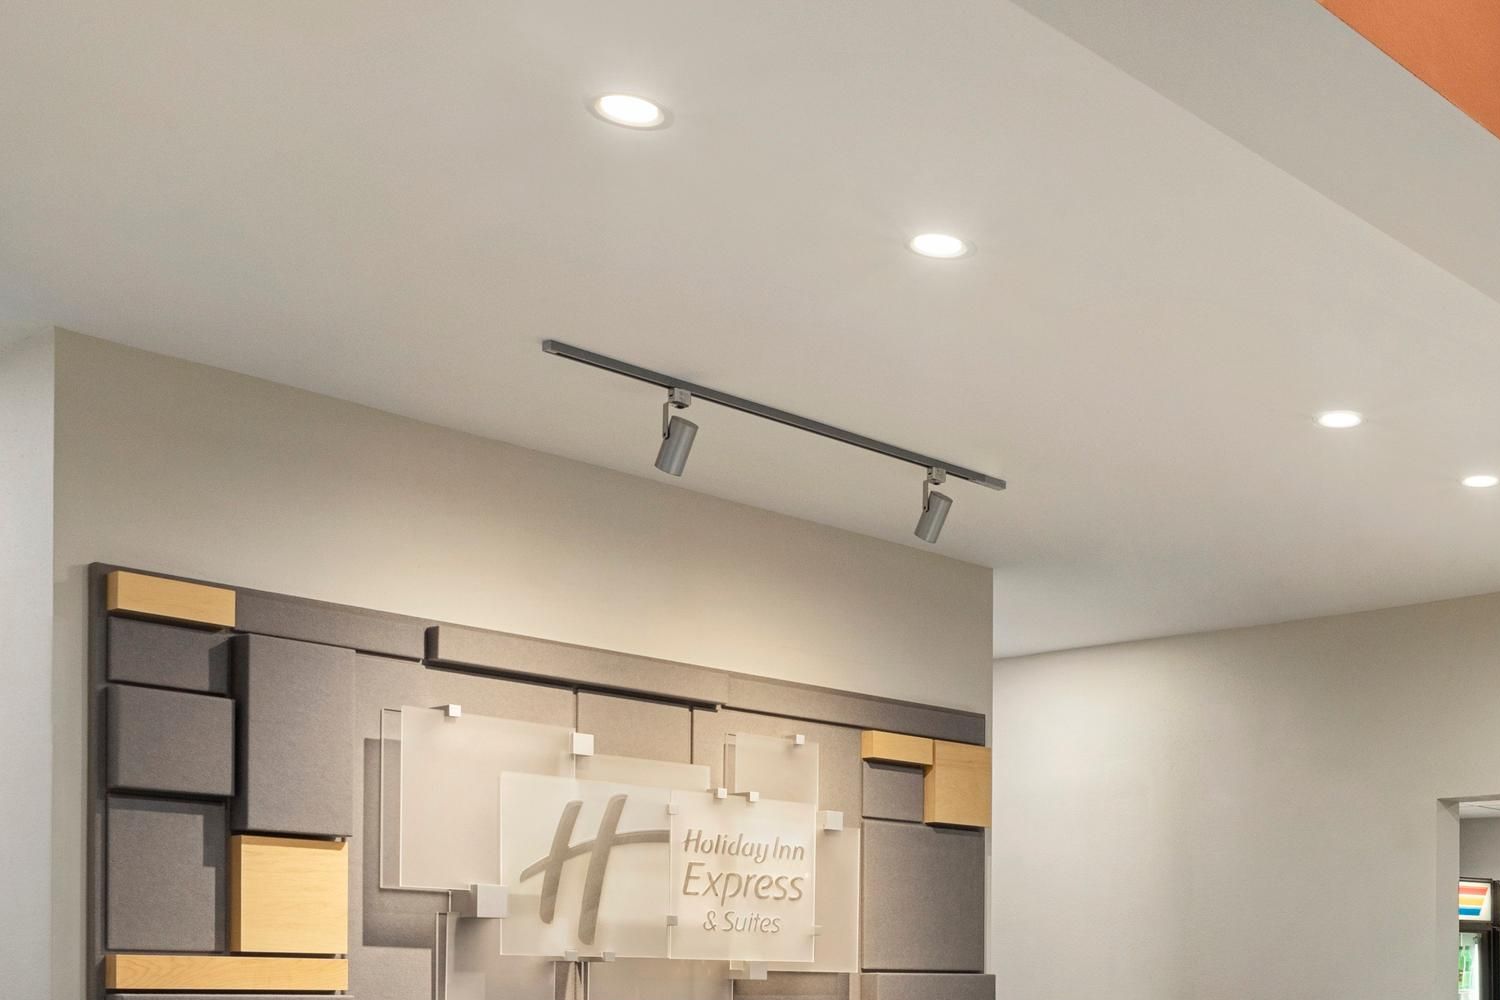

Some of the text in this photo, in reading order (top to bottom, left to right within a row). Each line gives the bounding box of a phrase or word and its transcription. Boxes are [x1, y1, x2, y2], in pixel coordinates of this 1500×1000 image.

[682, 828, 805, 864] Holiday Inn
[682, 861, 804, 907] Express
[702, 910, 782, 934] & Suites
